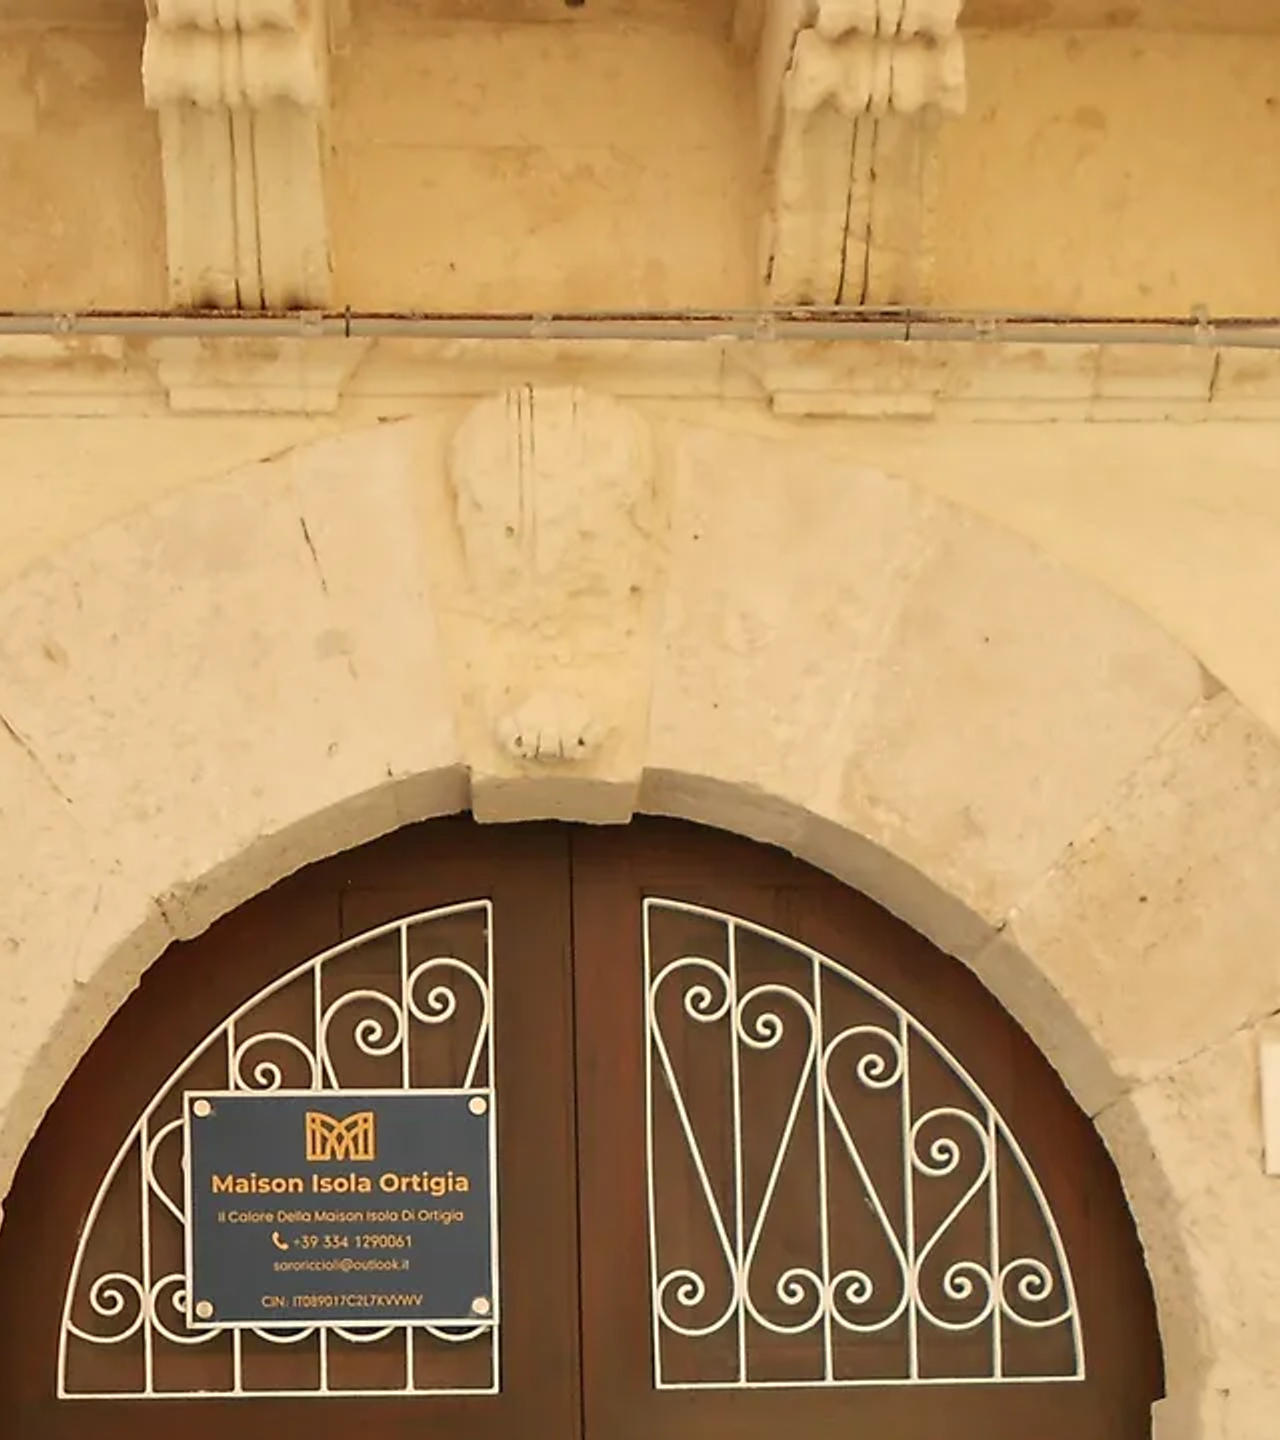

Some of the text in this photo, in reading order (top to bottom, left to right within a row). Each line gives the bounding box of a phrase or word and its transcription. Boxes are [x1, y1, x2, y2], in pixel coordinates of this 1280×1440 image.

[211, 1171, 469, 1196] Maison Isola Ortigia
[277, 1210, 311, 1223] Della
[315, 1210, 363, 1223] Maison
[366, 1209, 398, 1222] Isola
[402, 1209, 415, 1221] Di
[418, 1209, 464, 1225] Ortigia
[293, 1234, 412, 1249] +39 334 1290061
